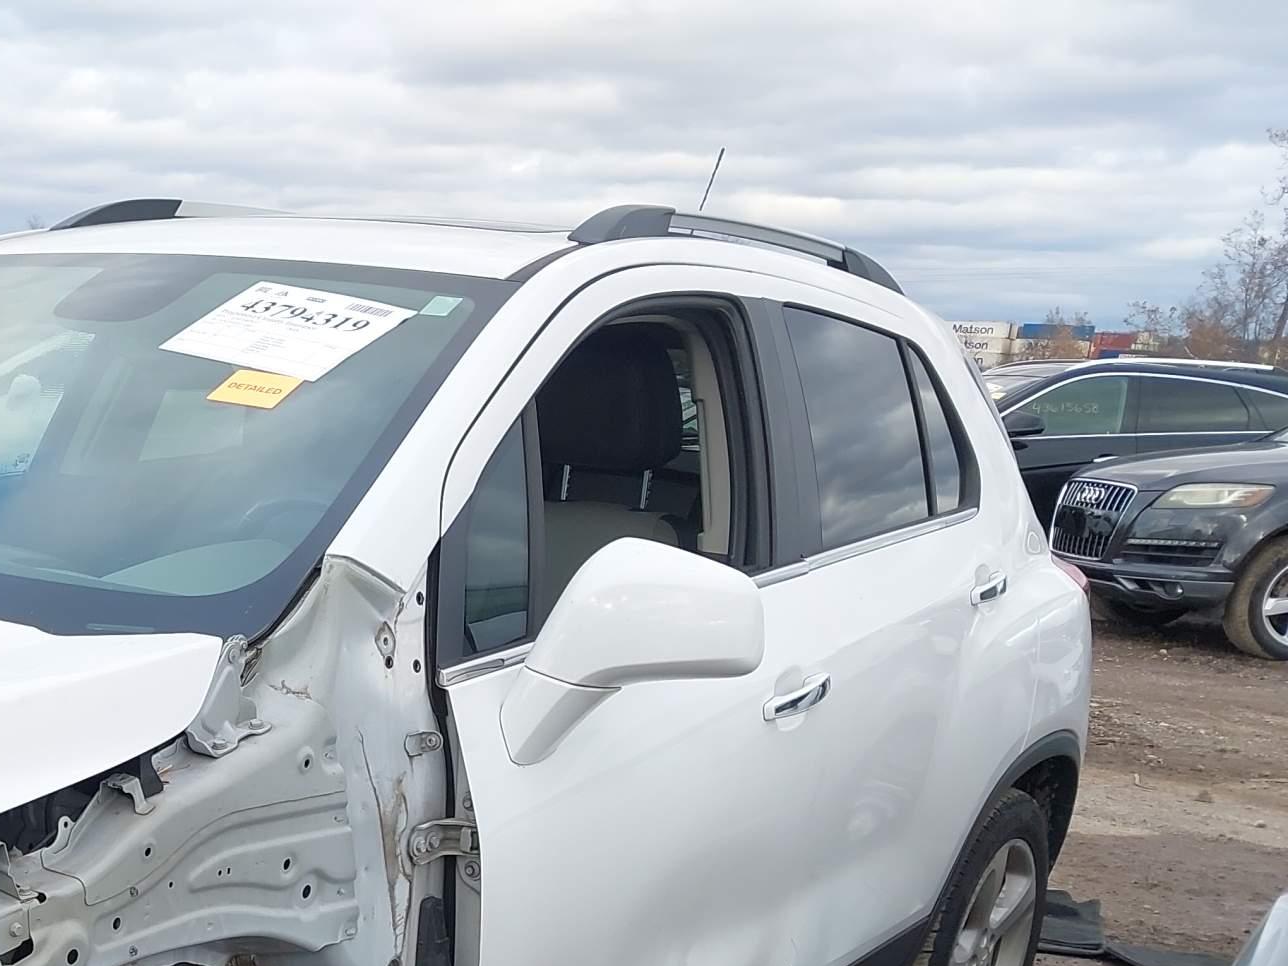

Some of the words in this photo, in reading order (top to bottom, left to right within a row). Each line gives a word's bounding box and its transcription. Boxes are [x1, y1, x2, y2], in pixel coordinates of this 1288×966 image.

[240, 299, 371, 332] 43794319
[952, 323, 994, 335] Matson
[964, 339, 989, 350] tson
[227, 381, 283, 396] DETAILED
